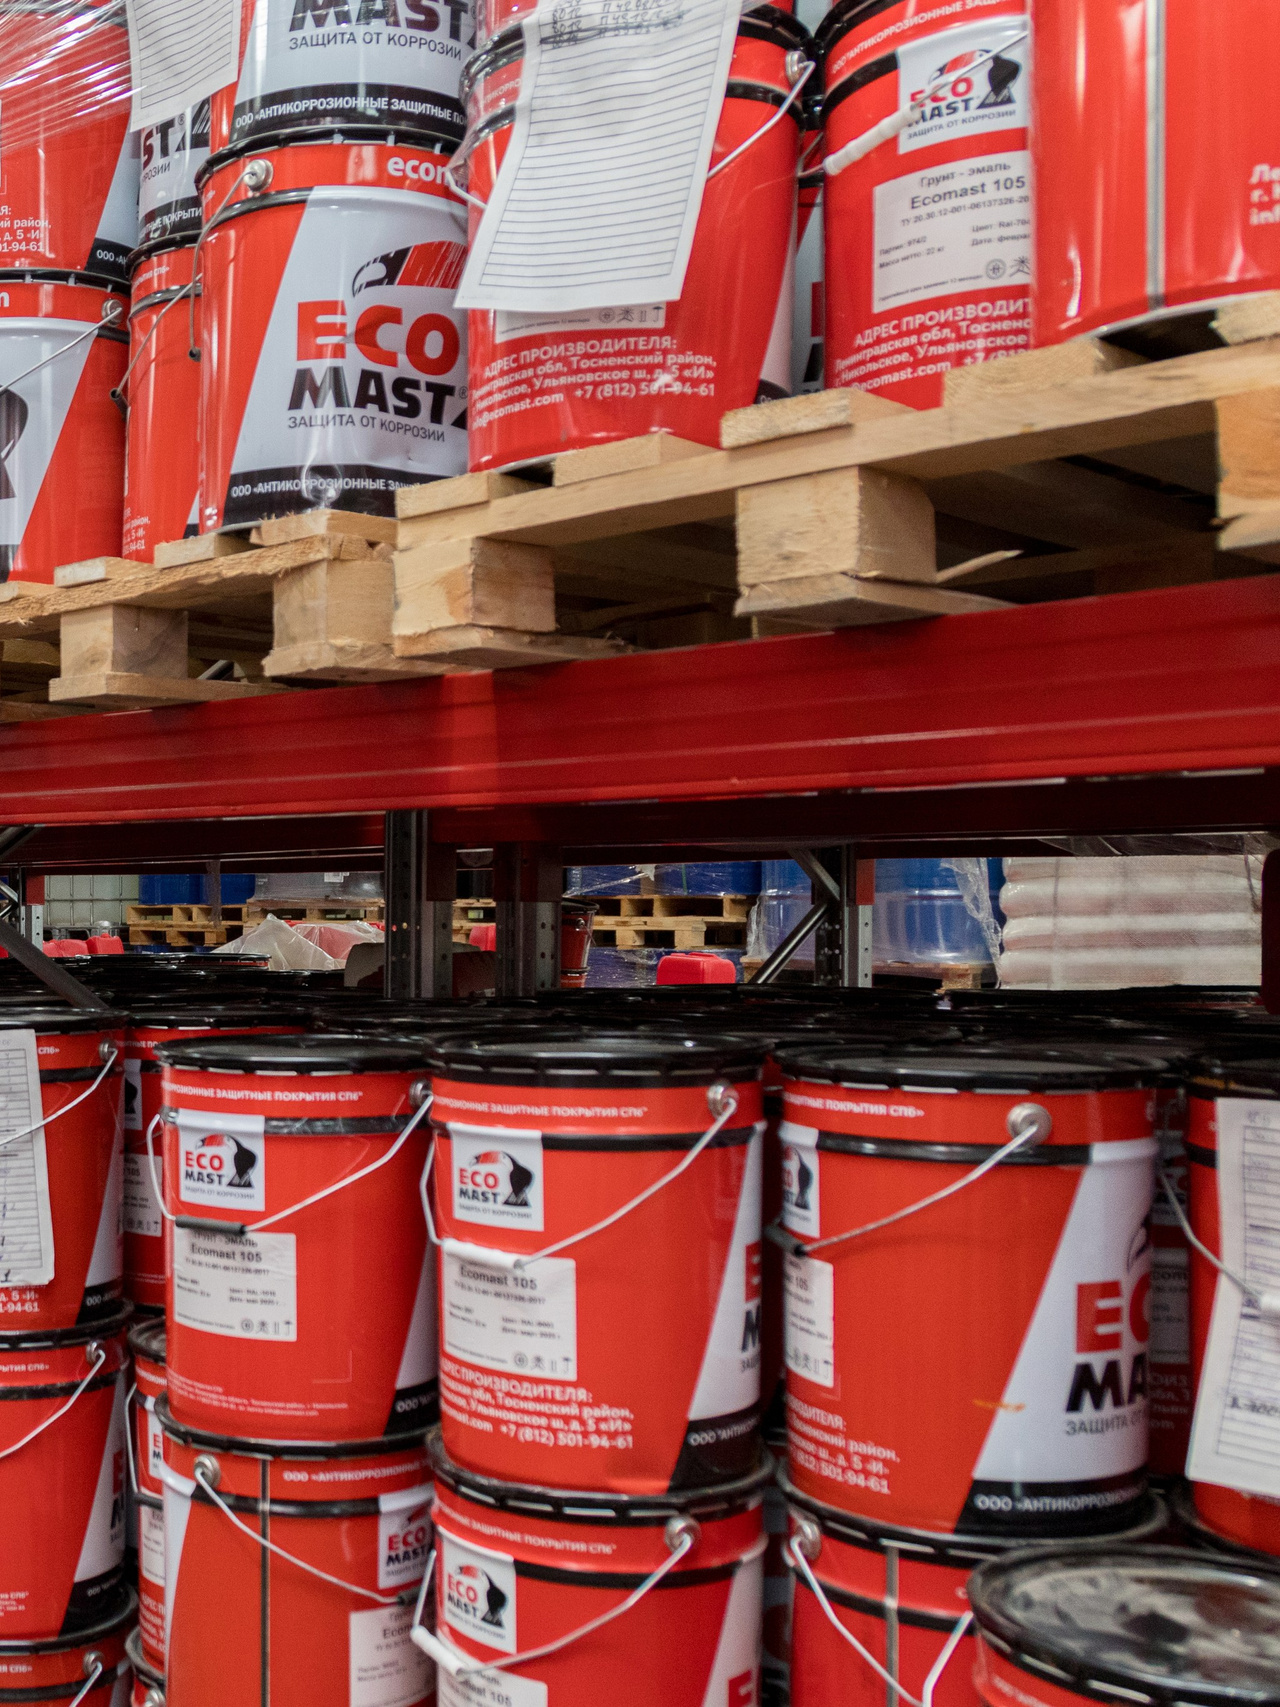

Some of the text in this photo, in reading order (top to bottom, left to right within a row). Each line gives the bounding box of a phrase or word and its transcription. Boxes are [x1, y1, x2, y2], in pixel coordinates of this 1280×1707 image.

[289, 0, 469, 42] MAST
[289, 31, 462, 60] ЗАЩИТА ОТ КОРРОЗИИ
[236, 112, 254, 128] ООО
[391, 98, 451, 120] ЗАЩИТНЫЕ
[907, 110, 1016, 140] ЗАЩИТА ОТ КОРРОЗИИ
[908, 98, 975, 127] AST
[920, 172, 956, 187] Грунт
[968, 163, 1011, 176] эмаль
[911, 176, 1026, 209] Ecomast 105
[14, 220, 51, 229] район,
[297, 300, 460, 375] ECO
[854, 320, 899, 347] АДРЕС
[485, 336, 677, 378] АДРЕС ПРОИЗВОДИТЕЛЯ:
[570, 352, 663, 368] Тосненский
[666, 353, 716, 367] район,
[835, 335, 918, 372] Ленинградская
[842, 334, 1027, 383] Никольское, Ульяновское
[288, 366, 455, 424] MAST
[575, 385, 592, 398] +7
[597, 383, 635, 399] (812)
[288, 415, 445, 442] ЗАЩИТА ОТ КОРРОЗИИ
[232, 486, 251, 497] ООО
[216, 1090, 272, 1101] ЗАЩИТНЫЕ
[275, 1091, 336, 1101] ПОКРЫТИЯ
[826, 1099, 887, 1116] ПОКРЫТИЯ
[491, 1103, 549, 1116] ЗАЩИТНЫЕ
[552, 1106, 618, 1117] ПОКРЫТИЯ
[186, 1151, 224, 1171] ECO
[185, 1170, 225, 1186] MAST
[460, 1169, 498, 1188] ECO
[459, 1188, 500, 1203] MAST
[191, 1244, 262, 1263] Ecomast 105
[461, 1265, 538, 1290] Ecomast 105
[462, 1369, 592, 1402] ПРОИЗВОДИТЕЛЯ:
[497, 1391, 634, 1420] Тосненский район,
[500, 1424, 634, 1449] +7 (812) 501-94-61
[848, 1440, 900, 1462] район,
[283, 1471, 308, 1482] ООО
[820, 1461, 891, 1495] 501-94-61
[975, 1494, 1013, 1511] ООО
[388, 1528, 426, 1550] ECO
[448, 1578, 478, 1603] ECO
[491, 1690, 512, 1707] 105
